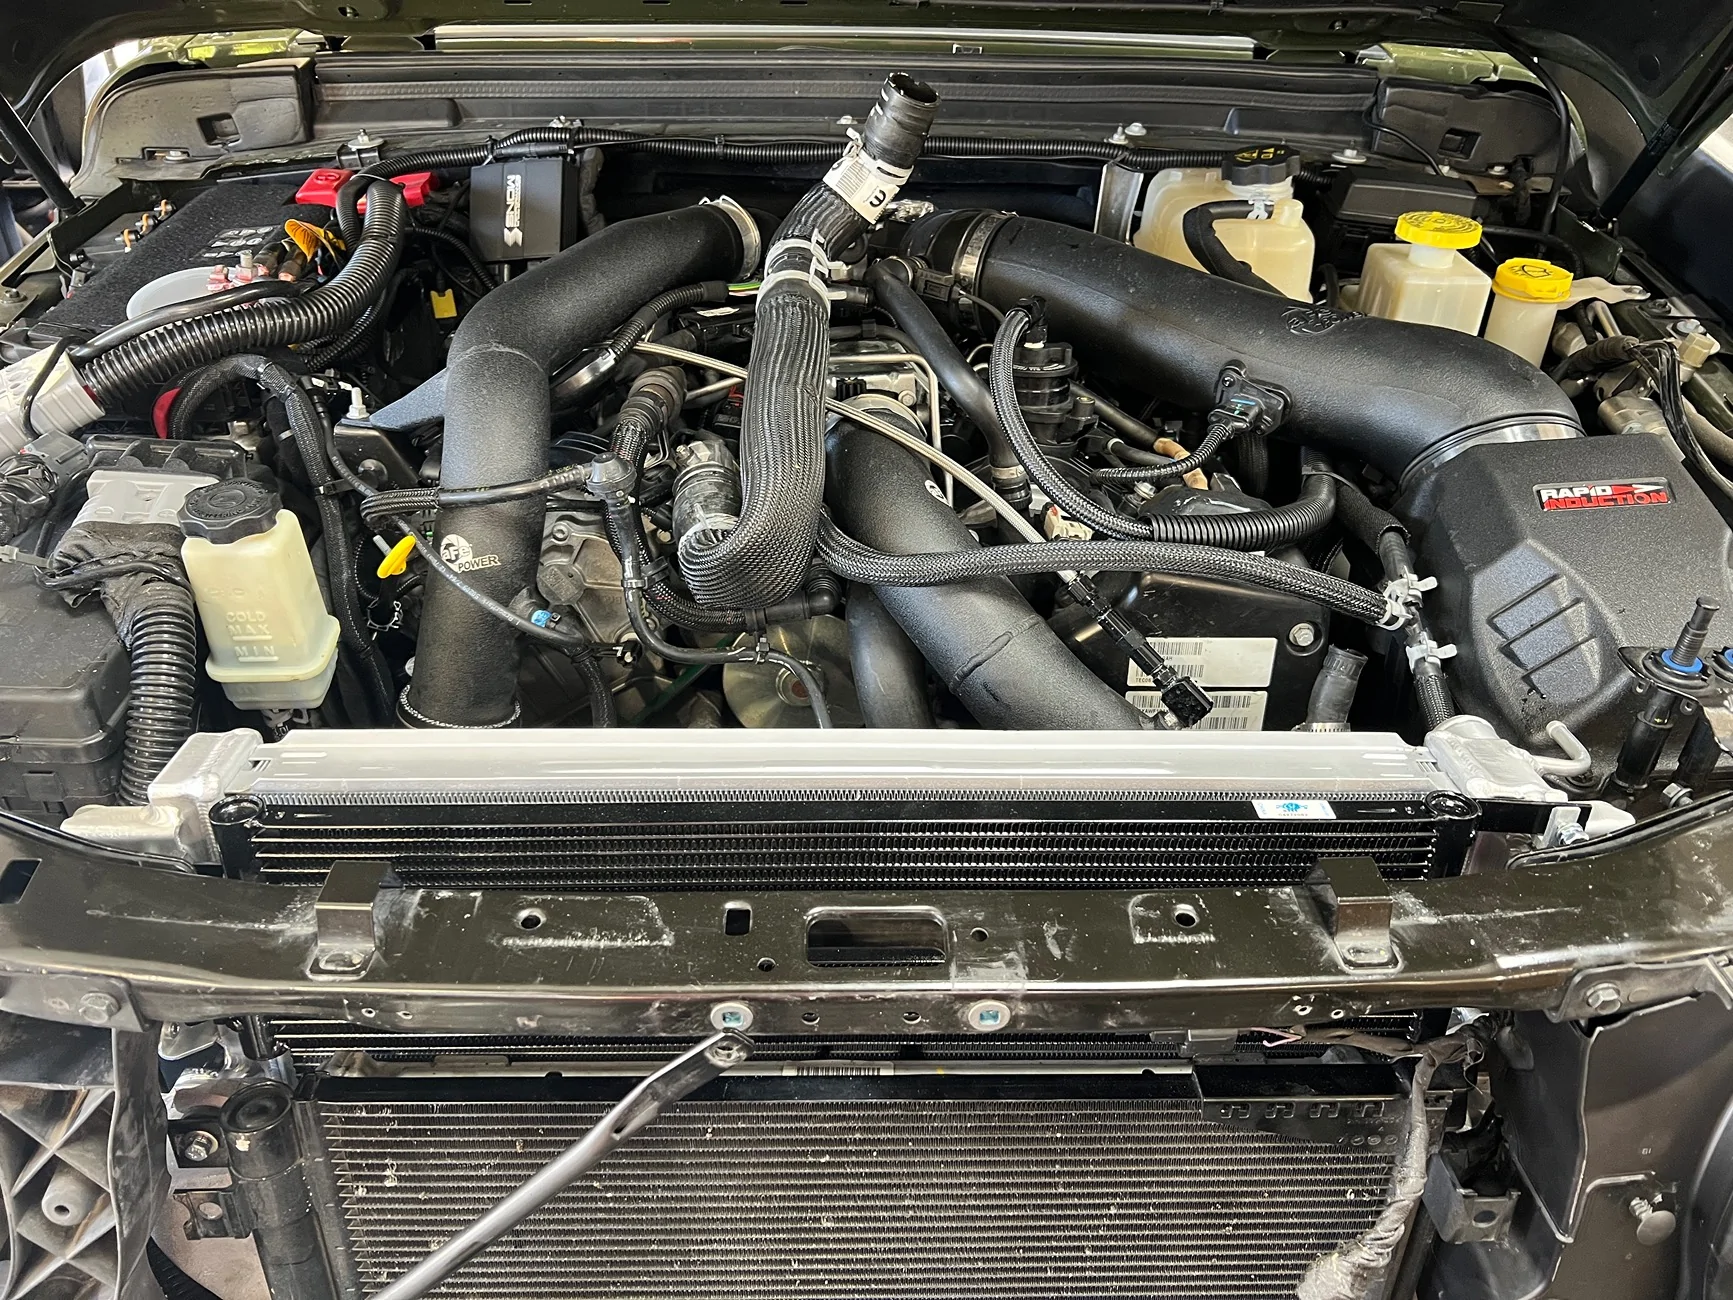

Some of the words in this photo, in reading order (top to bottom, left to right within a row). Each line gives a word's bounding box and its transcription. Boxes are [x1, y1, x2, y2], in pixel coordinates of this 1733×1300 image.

[1540, 484, 1612, 502] RAPID
[1544, 492, 1667, 511] INDUCTION
[458, 555, 498, 571] POWER
[226, 611, 266, 622] COLD
[227, 624, 271, 635] MAX
[234, 646, 275, 657] MIN
